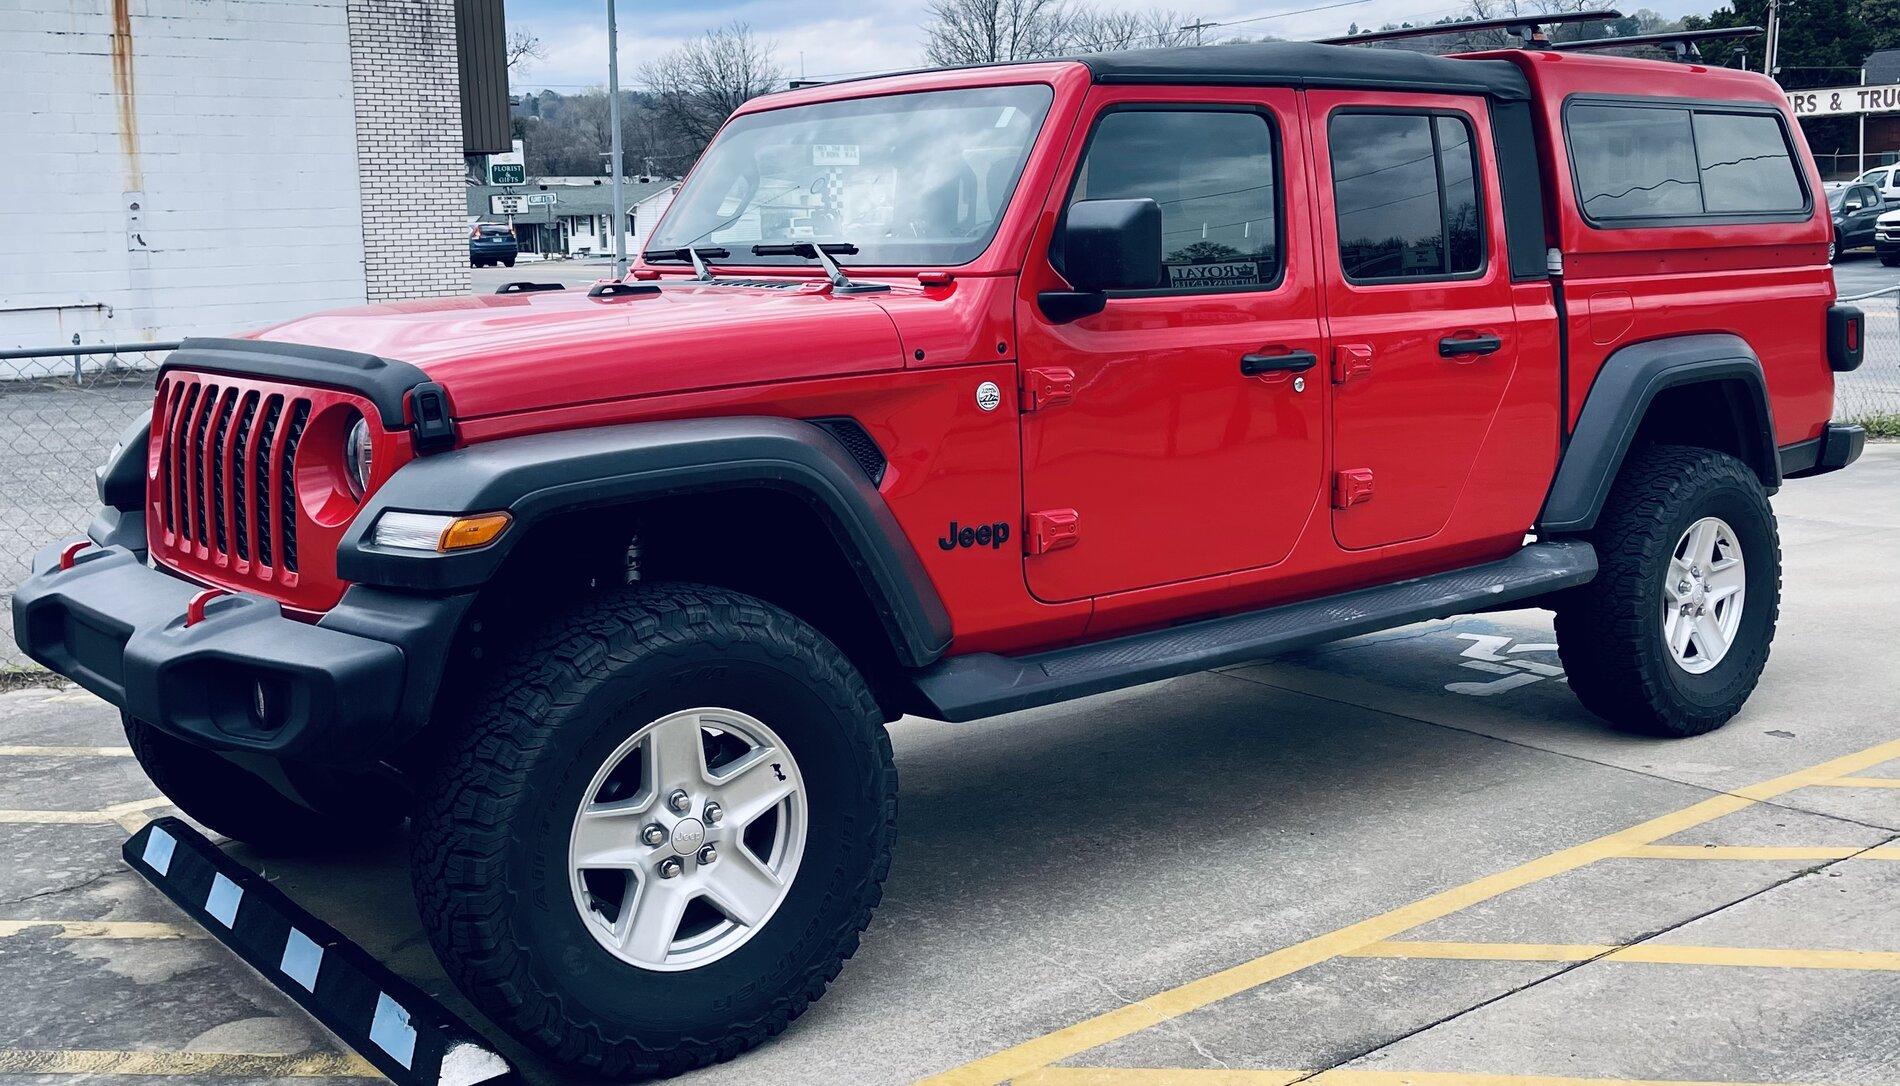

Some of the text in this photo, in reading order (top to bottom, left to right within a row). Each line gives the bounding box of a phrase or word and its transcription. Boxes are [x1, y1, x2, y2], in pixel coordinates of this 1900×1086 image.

[1829, 92, 1842, 111] &
[1857, 89, 1900, 109] TRU
[938, 522, 1009, 550] Jeep
[675, 827, 701, 841] Jeep
